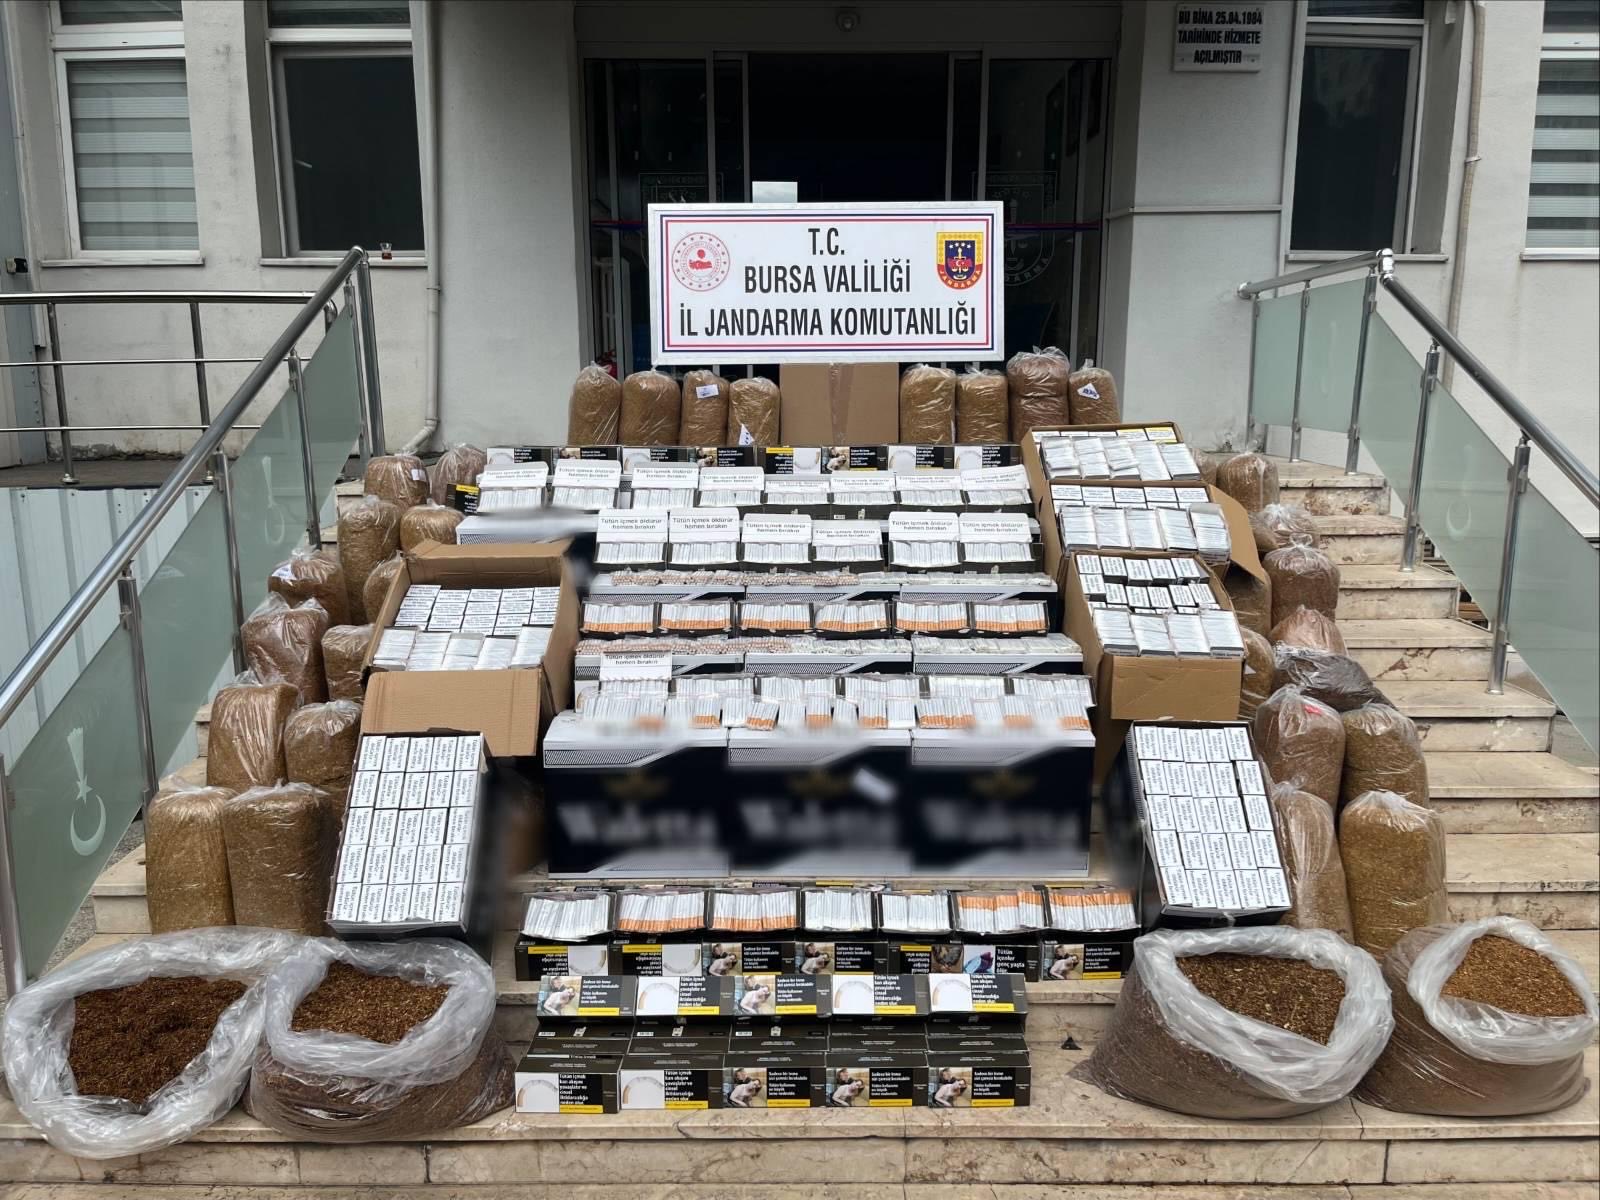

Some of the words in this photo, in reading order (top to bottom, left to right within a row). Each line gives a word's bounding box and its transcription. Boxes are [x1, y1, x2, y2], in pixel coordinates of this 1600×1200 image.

[1179, 11, 1191, 24] BU
[1193, 8, 1213, 25] BİNA
[1178, 28, 1222, 44] TARİHİNDE
[1224, 28, 1261, 44] HİZMETE
[1193, 49, 1242, 65] AÇILMIŞTIR
[808, 228, 845, 256] T.C.
[745, 265, 817, 293] BURSA
[824, 259, 911, 293] VALİLİĞİ
[939, 269, 981, 288] JANDARMA
[680, 303, 698, 336] İL
[705, 308, 824, 336] JANDARMA
[831, 300, 976, 336] KOMUTANLIĞI
[996, 954, 1015, 962] içenler
